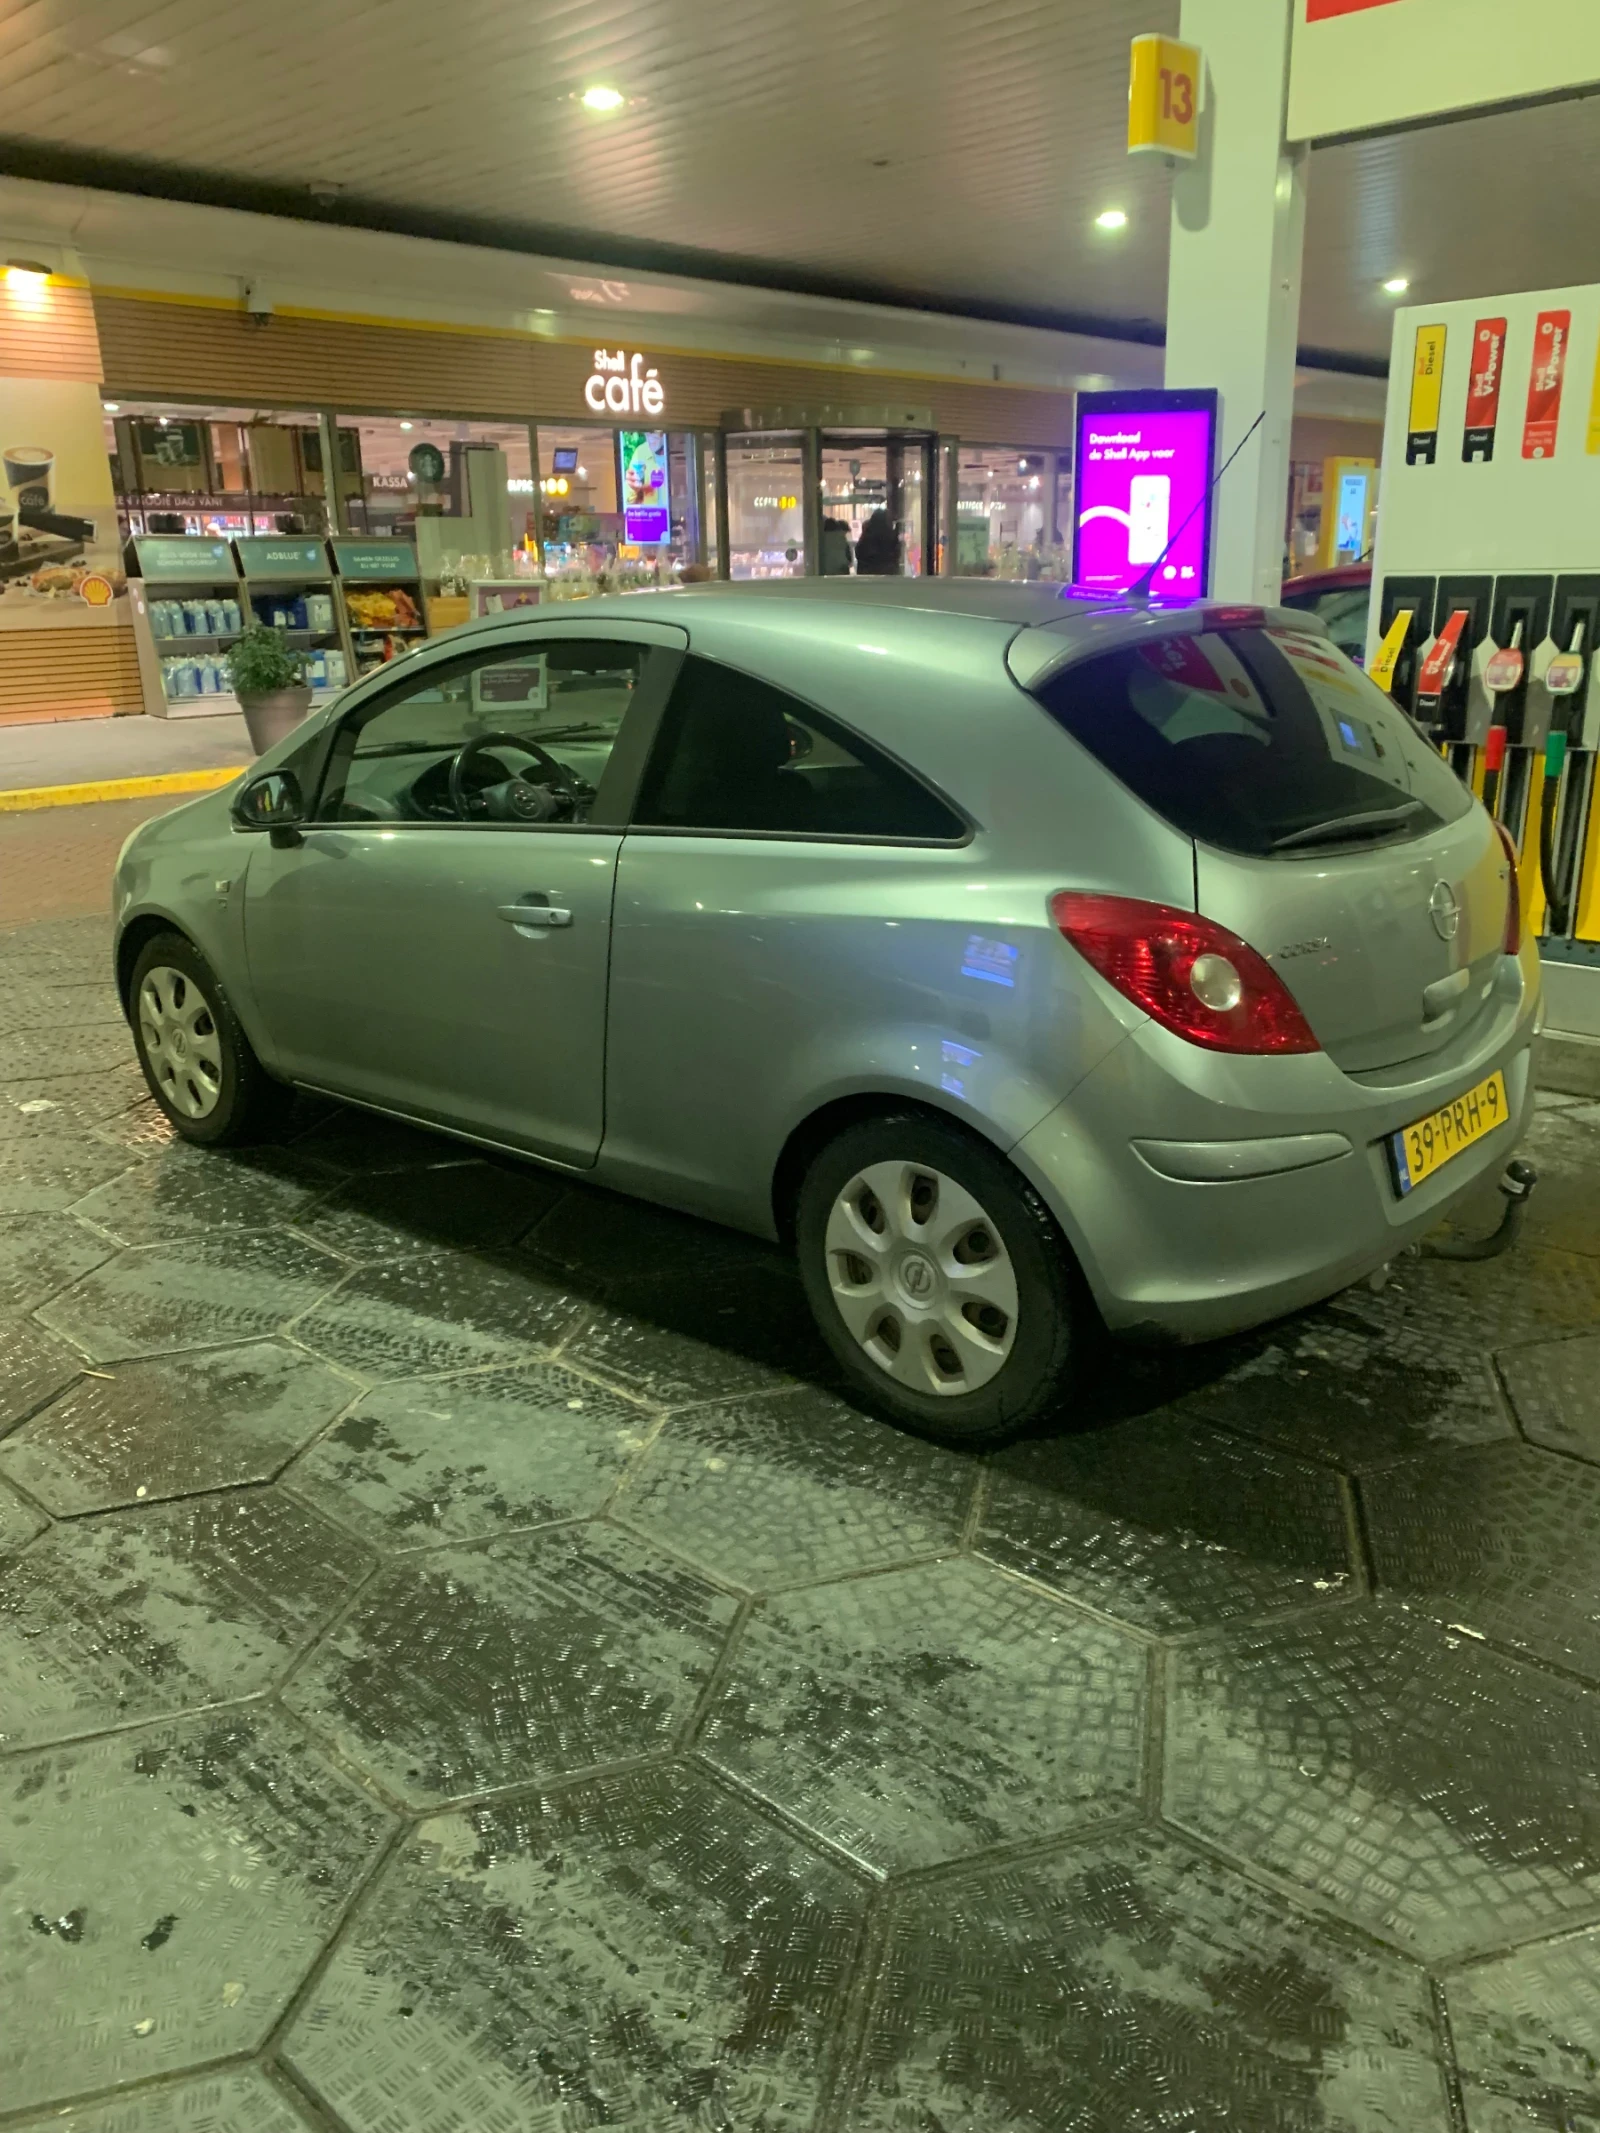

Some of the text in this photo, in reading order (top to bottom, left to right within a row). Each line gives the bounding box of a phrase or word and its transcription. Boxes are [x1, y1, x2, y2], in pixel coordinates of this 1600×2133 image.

[1159, 68, 1193, 125] 13
[594, 348, 625, 371] Shell
[1425, 341, 1436, 375] Diesel
[1482, 333, 1500, 397] V-Power
[1545, 326, 1563, 391] V-Power
[585, 353, 664, 414] café
[1089, 430, 1141, 445] Download
[1089, 447, 1175, 462] de Shell App voor
[372, 476, 408, 488] KASSA
[174, 497, 195, 506] DAG
[266, 551, 300, 560] ADBLUE
[1381, 647, 1396, 673] Diesel
[1410, 1081, 1498, 1173] 39-PRH-9
